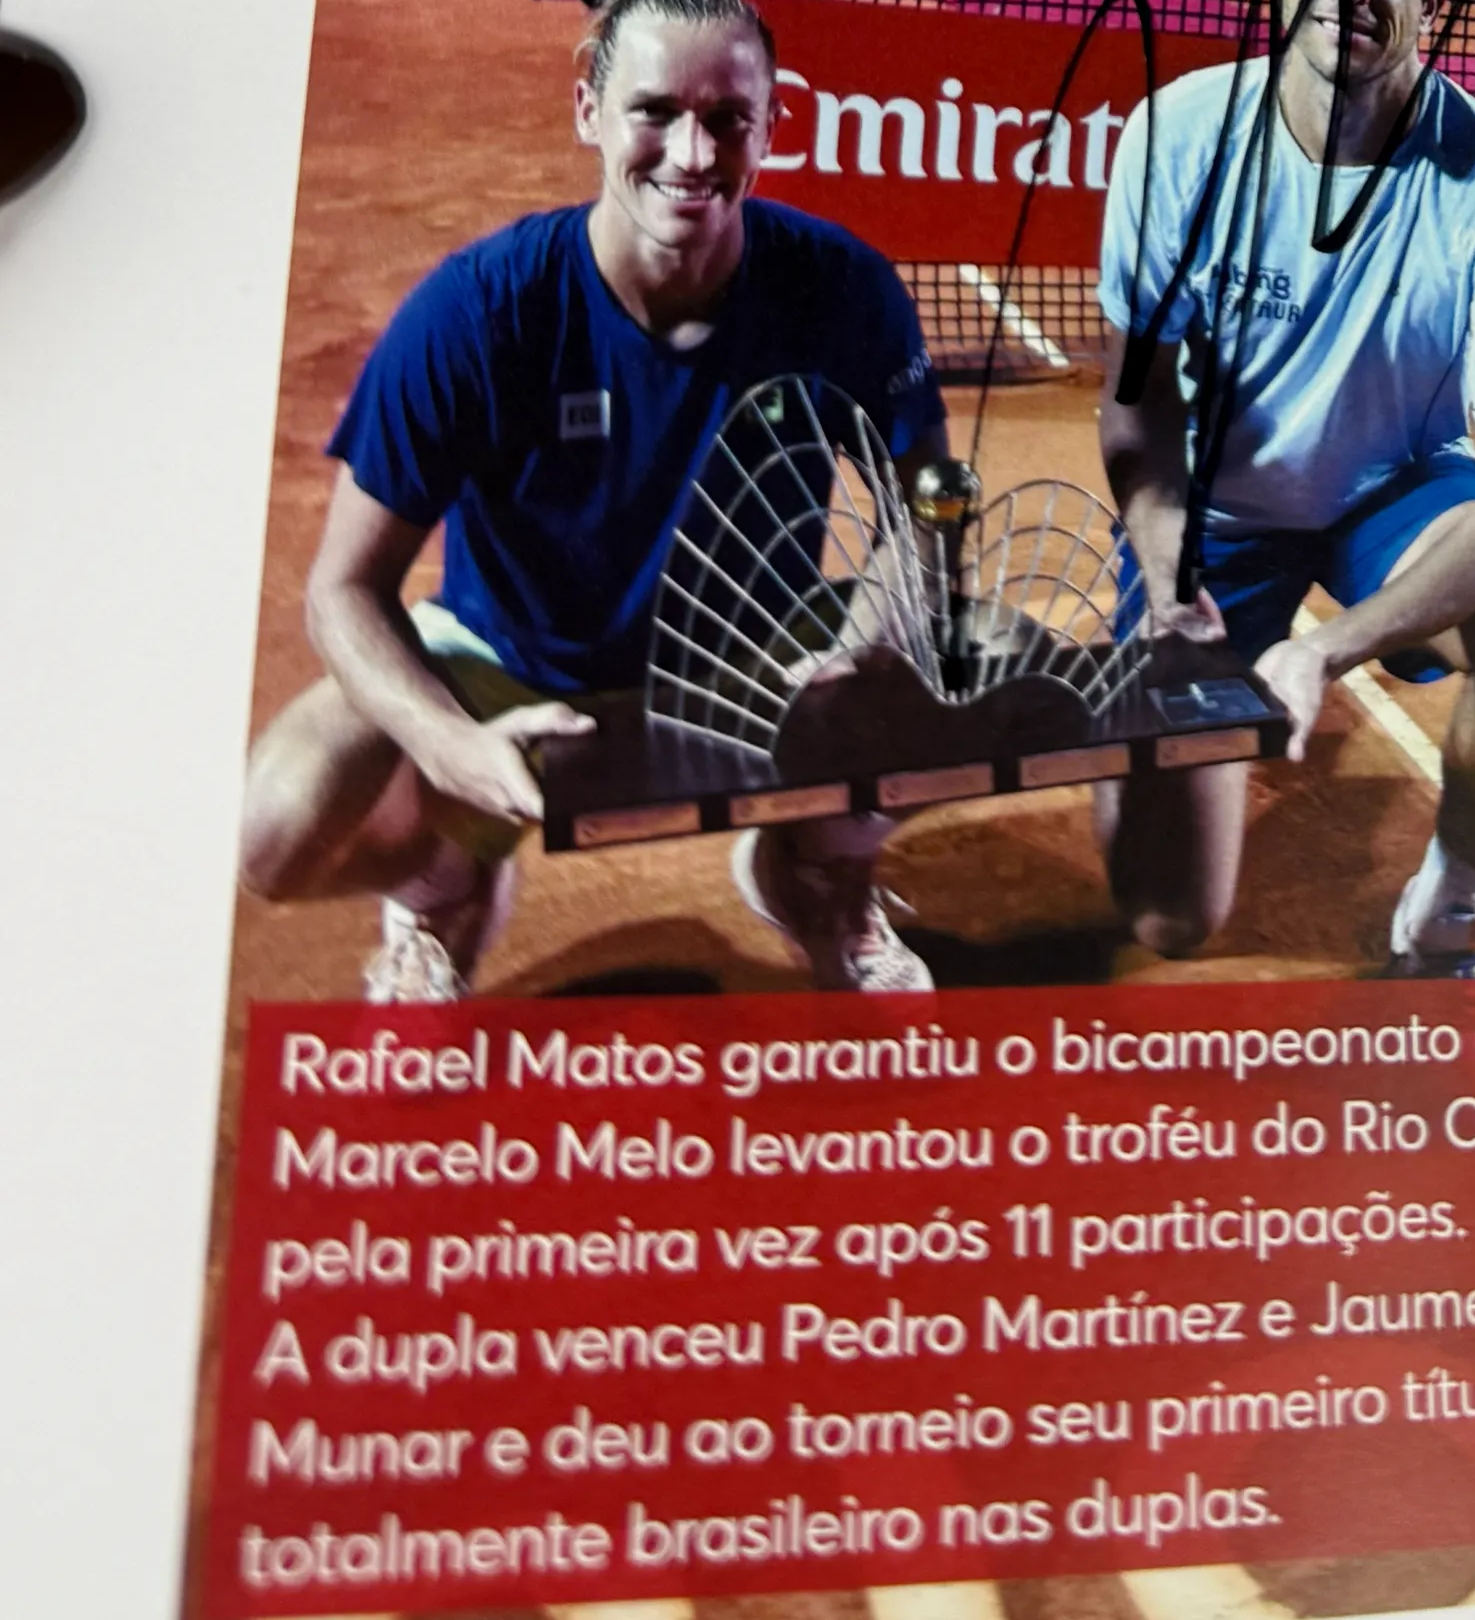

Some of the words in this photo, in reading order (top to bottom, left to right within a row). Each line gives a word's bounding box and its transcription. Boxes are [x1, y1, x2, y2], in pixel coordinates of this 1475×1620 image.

[280, 1029, 488, 1095] Rafael
[506, 1031, 703, 1089] Matos
[720, 1025, 979, 1098] garantiu
[996, 1036, 1034, 1072] o
[1051, 1014, 1461, 1082] bicampeonato
[273, 1121, 539, 1189] Marcelo
[555, 1117, 713, 1181] Melo
[730, 1117, 992, 1174] levantou
[1010, 1125, 1047, 1165] o
[1065, 1103, 1237, 1163] troféu
[1252, 1102, 1325, 1154] do
[1341, 1100, 1427, 1153] Rio
[263, 1220, 411, 1302] pela
[428, 1216, 697, 1296] primeira
[716, 1223, 822, 1269] vez
[835, 1207, 989, 1277] após
[1002, 1203, 1051, 1258] 11
[1071, 1191, 1468, 1268] participações.
[253, 1320, 308, 1387] A
[324, 1313, 516, 1395] dupla
[535, 1320, 764, 1370] venceu
[781, 1299, 964, 1361] Pedro
[982, 1291, 1244, 1355] Martínez
[1259, 1298, 1295, 1337] e
[247, 1417, 473, 1486] Munar
[483, 1426, 529, 1471] e
[543, 1404, 668, 1471] deu
[685, 1420, 772, 1460] ao
[787, 1393, 1012, 1458] torneio
[1026, 1401, 1130, 1445] seu
[1148, 1374, 1389, 1451] primeiro
[239, 1511, 611, 1588] totalmente
[626, 1496, 924, 1565] brasileiro
[939, 1500, 1053, 1546] nas
[1066, 1474, 1281, 1547] duplas.
